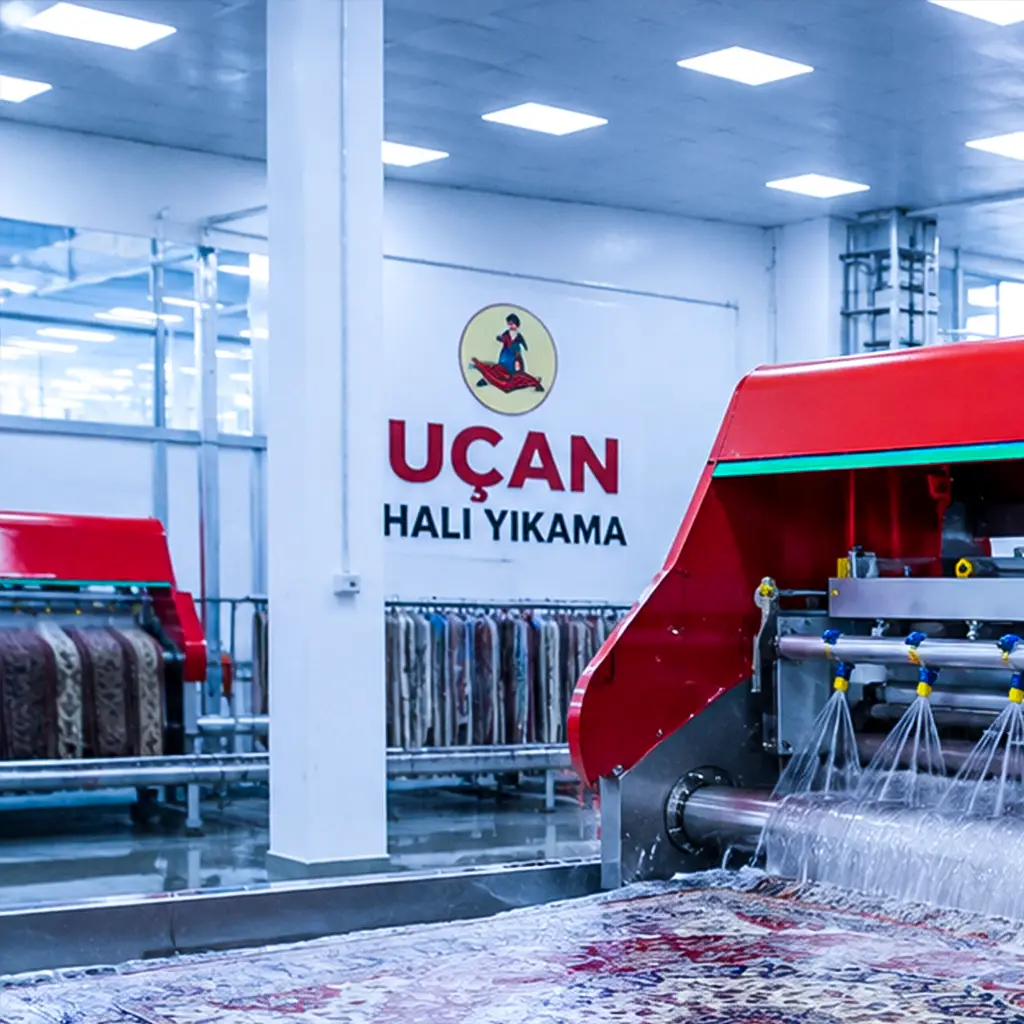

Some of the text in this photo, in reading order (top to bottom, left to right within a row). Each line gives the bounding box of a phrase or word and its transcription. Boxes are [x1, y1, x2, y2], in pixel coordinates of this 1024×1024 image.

[388, 418, 619, 503] UÇAN
[383, 503, 628, 547] HALI YIKAMA
